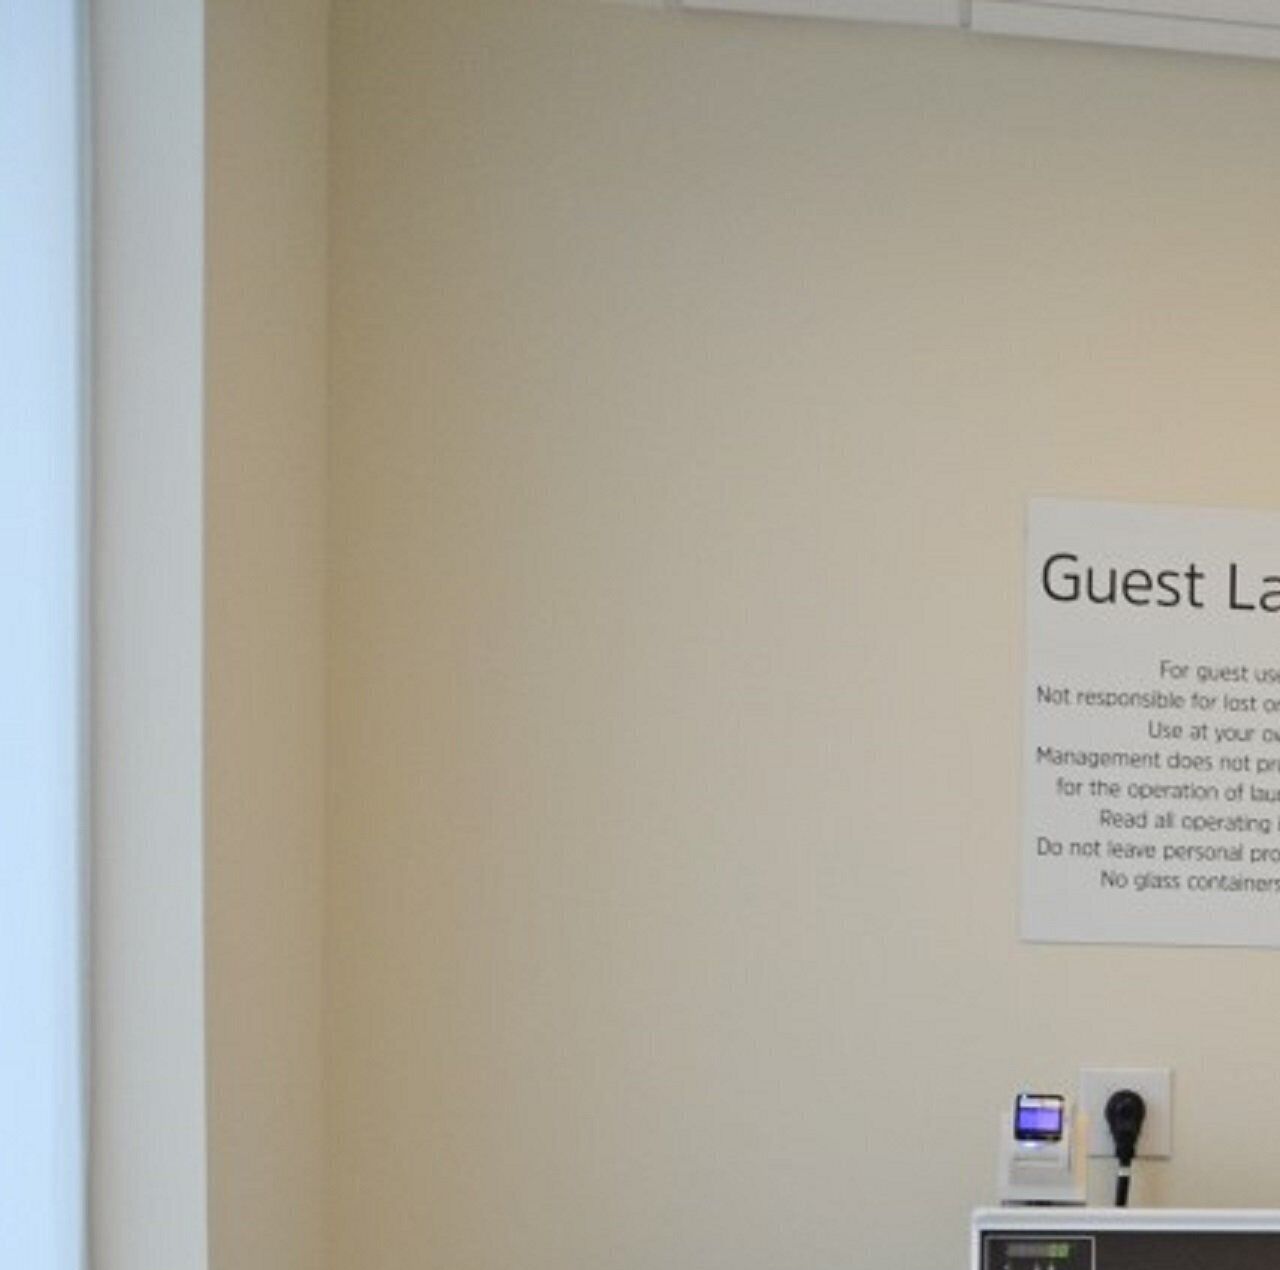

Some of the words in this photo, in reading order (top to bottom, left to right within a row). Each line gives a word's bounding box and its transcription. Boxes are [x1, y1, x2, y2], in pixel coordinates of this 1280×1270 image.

[1042, 552, 1206, 608] Guest
[1159, 659, 1190, 680] For
[1196, 664, 1249, 684] guest
[1036, 685, 1071, 706] Not
[1076, 688, 1186, 710] responsible
[1190, 692, 1217, 710] for
[1223, 694, 1258, 712] lost
[1148, 718, 1184, 739] Use
[1189, 723, 1208, 740] at
[1214, 726, 1255, 744] your
[1036, 746, 1161, 769] Management
[1167, 751, 1213, 771] does
[1219, 755, 1250, 772] not
[1056, 777, 1084, 796] for
[1089, 780, 1121, 798] the
[1127, 781, 1219, 800] operation
[1224, 783, 1244, 801] of
[1099, 808, 1148, 829] Read
[1154, 811, 1175, 829] all
[1181, 813, 1272, 834] operating
[1036, 836, 1063, 856] Do
[1069, 841, 1101, 857] not
[1106, 842, 1157, 859] leave
[1162, 843, 1244, 862] personal
[1100, 870, 1129, 889] No
[1134, 872, 1181, 892] glass
